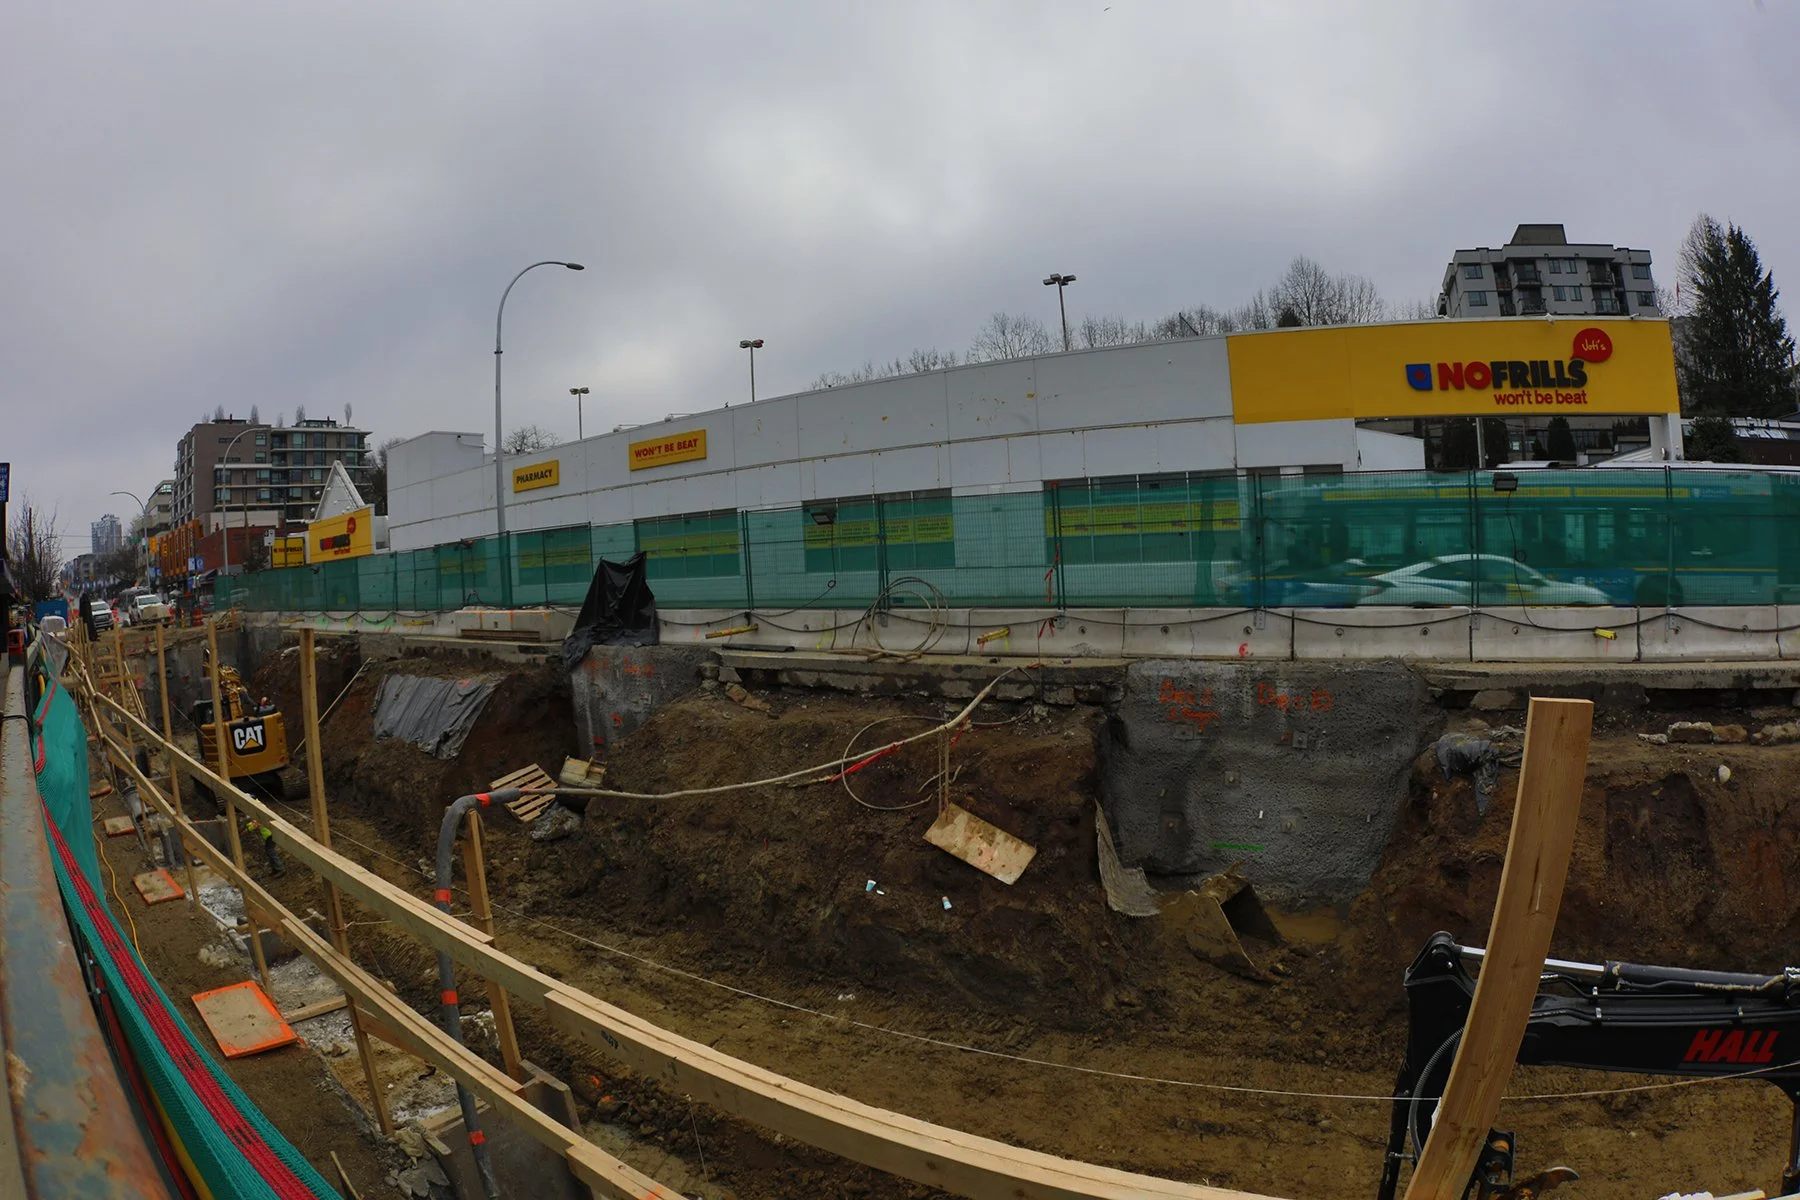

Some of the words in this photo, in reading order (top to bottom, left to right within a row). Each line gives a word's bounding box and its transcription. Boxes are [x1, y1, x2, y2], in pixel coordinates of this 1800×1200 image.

[1494, 390, 1533, 405] won't
[1535, 390, 1553, 405] be
[1556, 389, 1588, 404] beat
[634, 445, 662, 458] WON'T
[664, 443, 674, 453] BE
[677, 438, 699, 450] BEAT
[516, 468, 552, 484] PHARMACY
[233, 724, 264, 750] CAT
[1683, 1029, 1780, 1063] HALL
